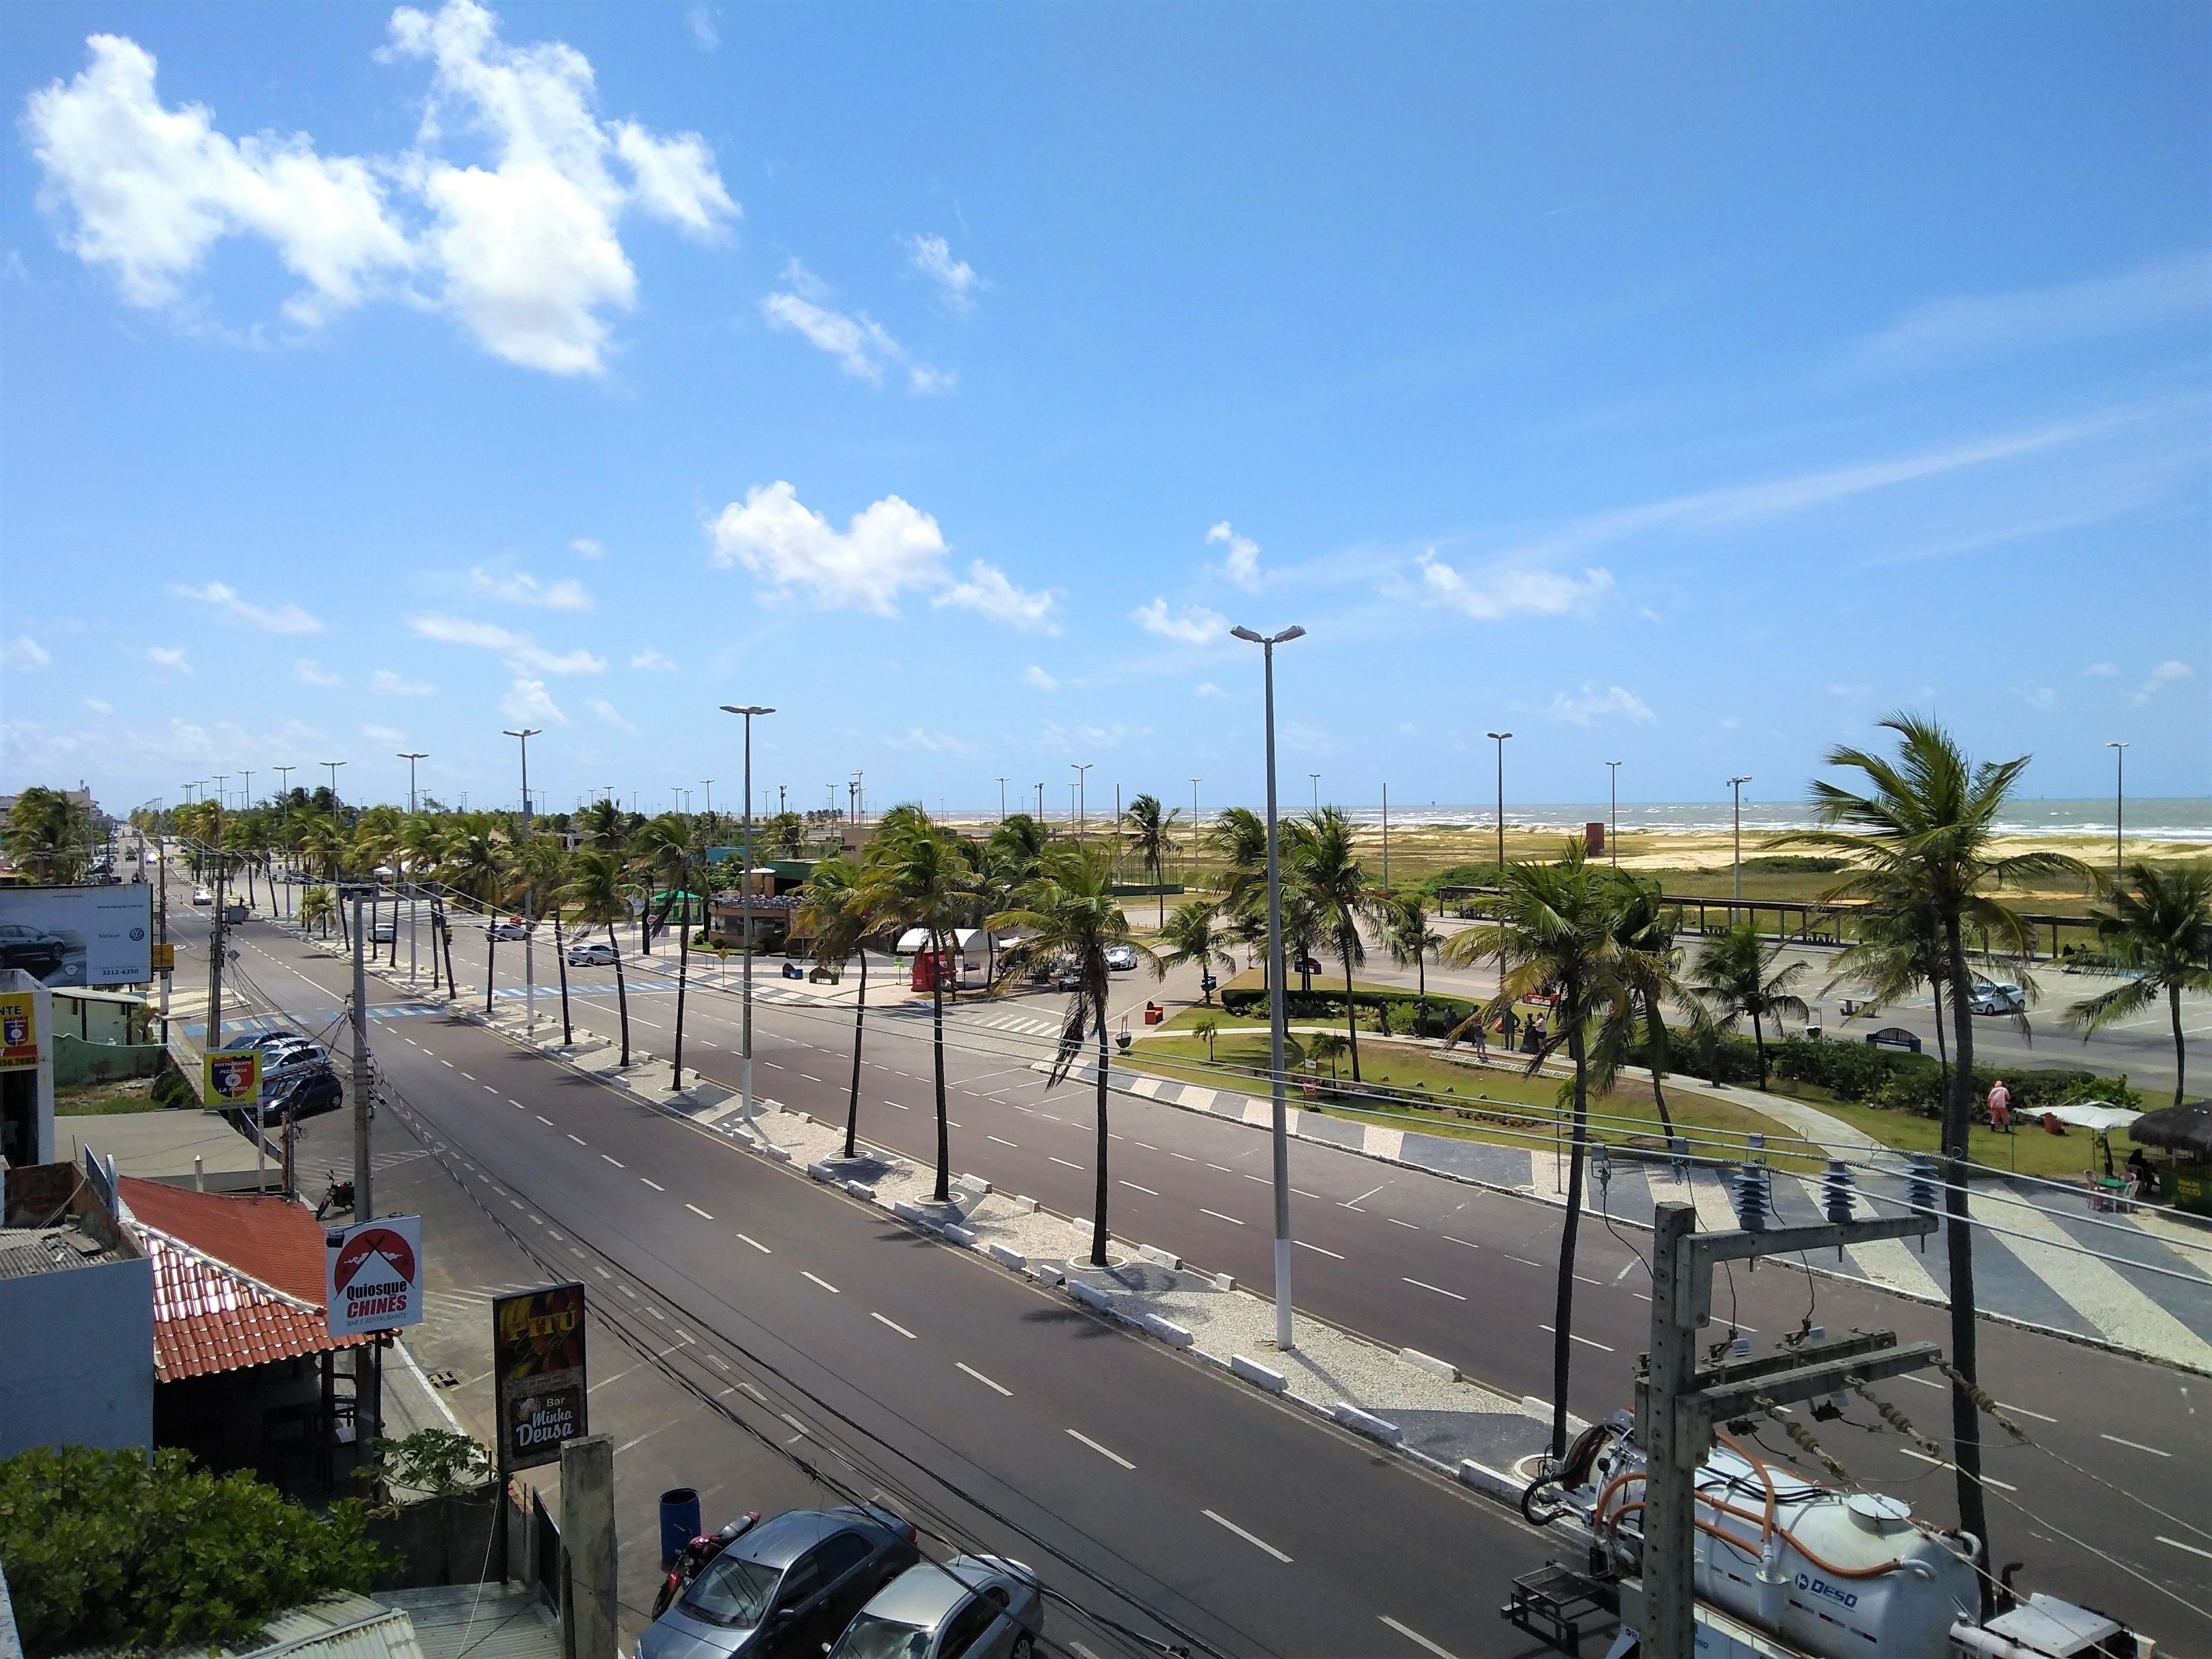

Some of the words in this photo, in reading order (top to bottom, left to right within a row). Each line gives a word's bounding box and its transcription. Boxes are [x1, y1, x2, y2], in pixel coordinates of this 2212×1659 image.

[347, 1281, 407, 1301] Quiosque
[347, 1294, 407, 1318] CHINÊS
[366, 1313, 407, 1323] RESTAURANTE
[547, 1397, 565, 1407] Bar
[532, 1408, 573, 1428] Minha
[516, 1423, 574, 1446] Deusa
[1810, 1579, 1858, 1608] DESO
